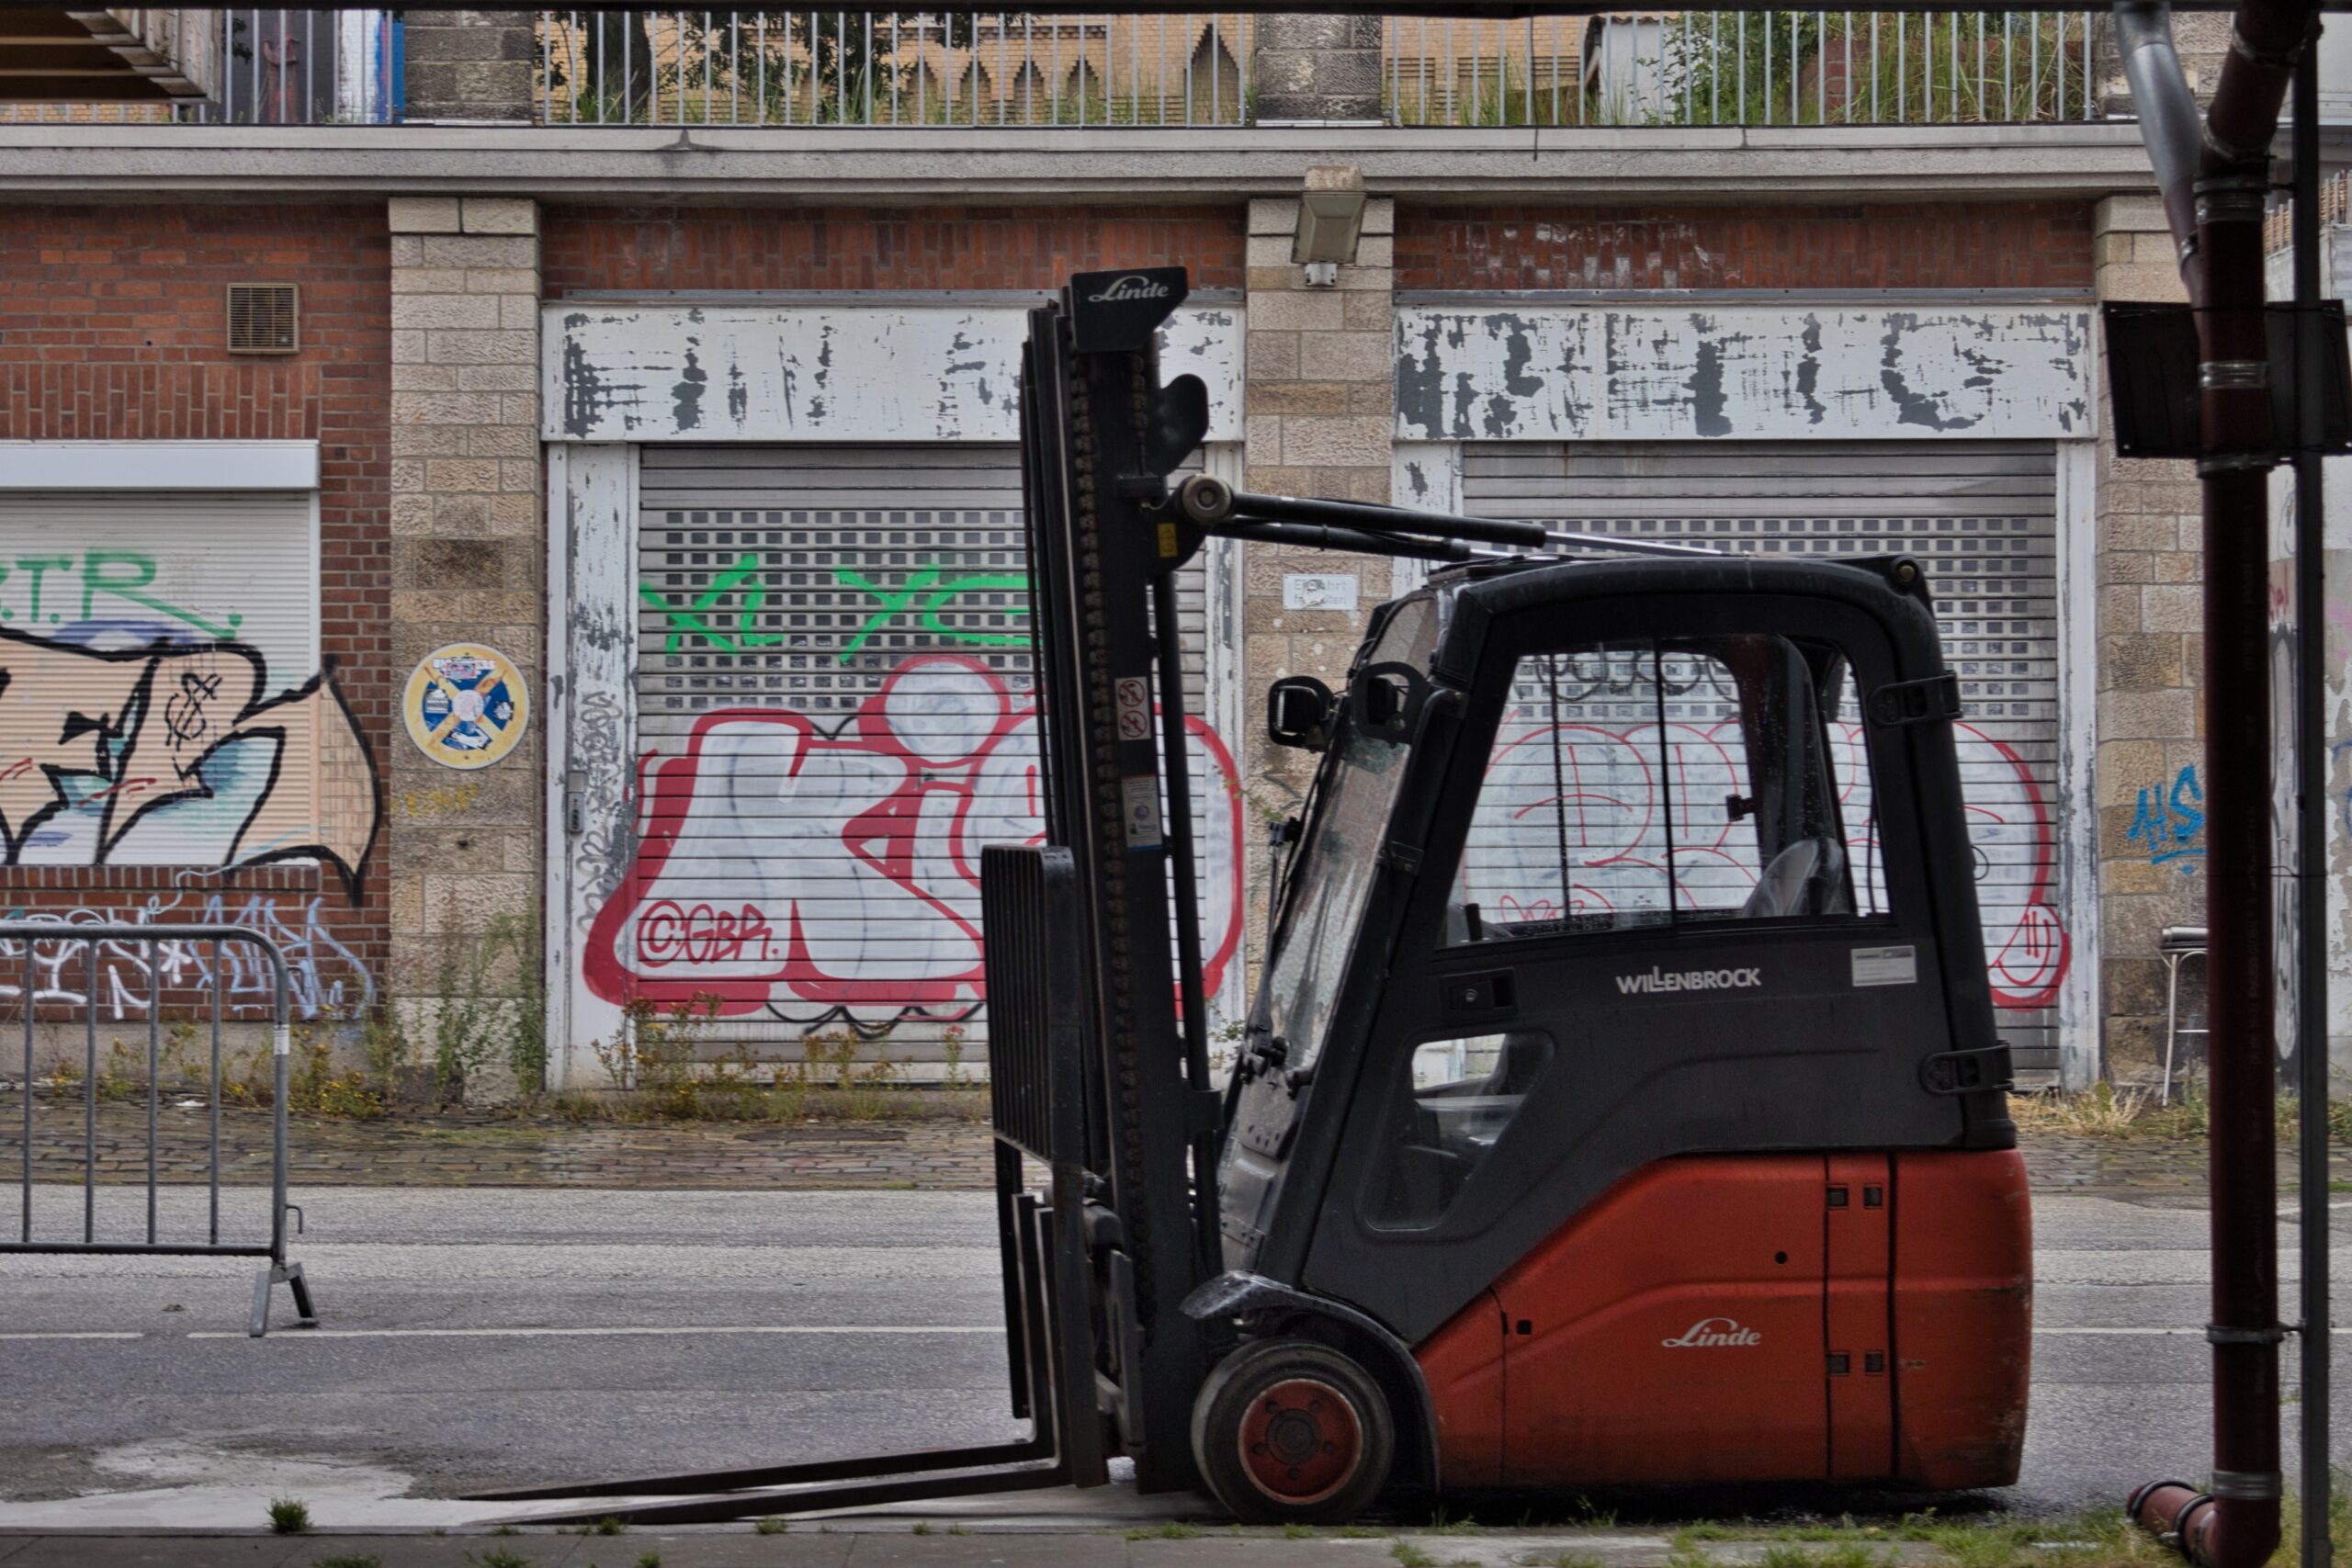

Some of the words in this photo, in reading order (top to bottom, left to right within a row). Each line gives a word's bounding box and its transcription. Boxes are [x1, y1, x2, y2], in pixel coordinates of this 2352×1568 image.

[1088, 275, 1170, 302] Linde
[1615, 965, 1762, 995] WILLENBROCK
[1661, 1317, 1762, 1348] Linde
